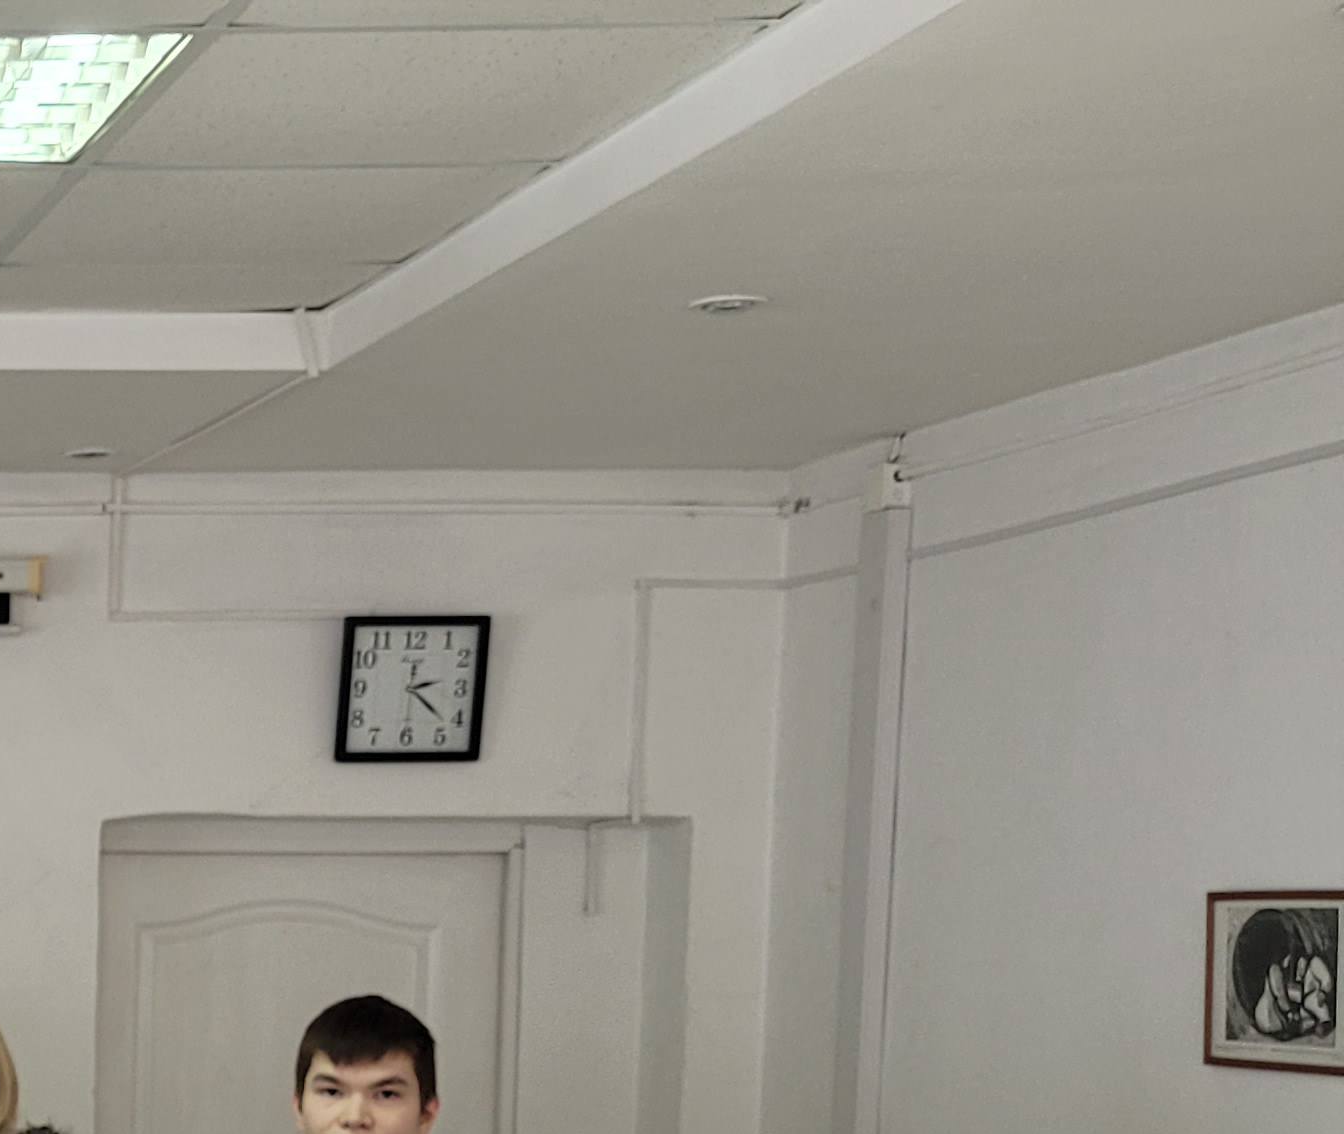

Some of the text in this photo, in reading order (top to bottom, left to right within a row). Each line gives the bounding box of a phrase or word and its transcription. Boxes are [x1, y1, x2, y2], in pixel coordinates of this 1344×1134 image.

[373, 630, 391, 650] 11
[404, 631, 428, 650] 12
[443, 630, 453, 650] 1
[355, 650, 377, 669] 10
[456, 649, 471, 668] 2
[354, 679, 367, 698] 9
[454, 679, 468, 698] 3
[350, 710, 364, 728] 8
[450, 709, 464, 727] 4
[369, 728, 381, 746] 7
[399, 727, 413, 746] 6
[433, 727, 446, 746] 5
